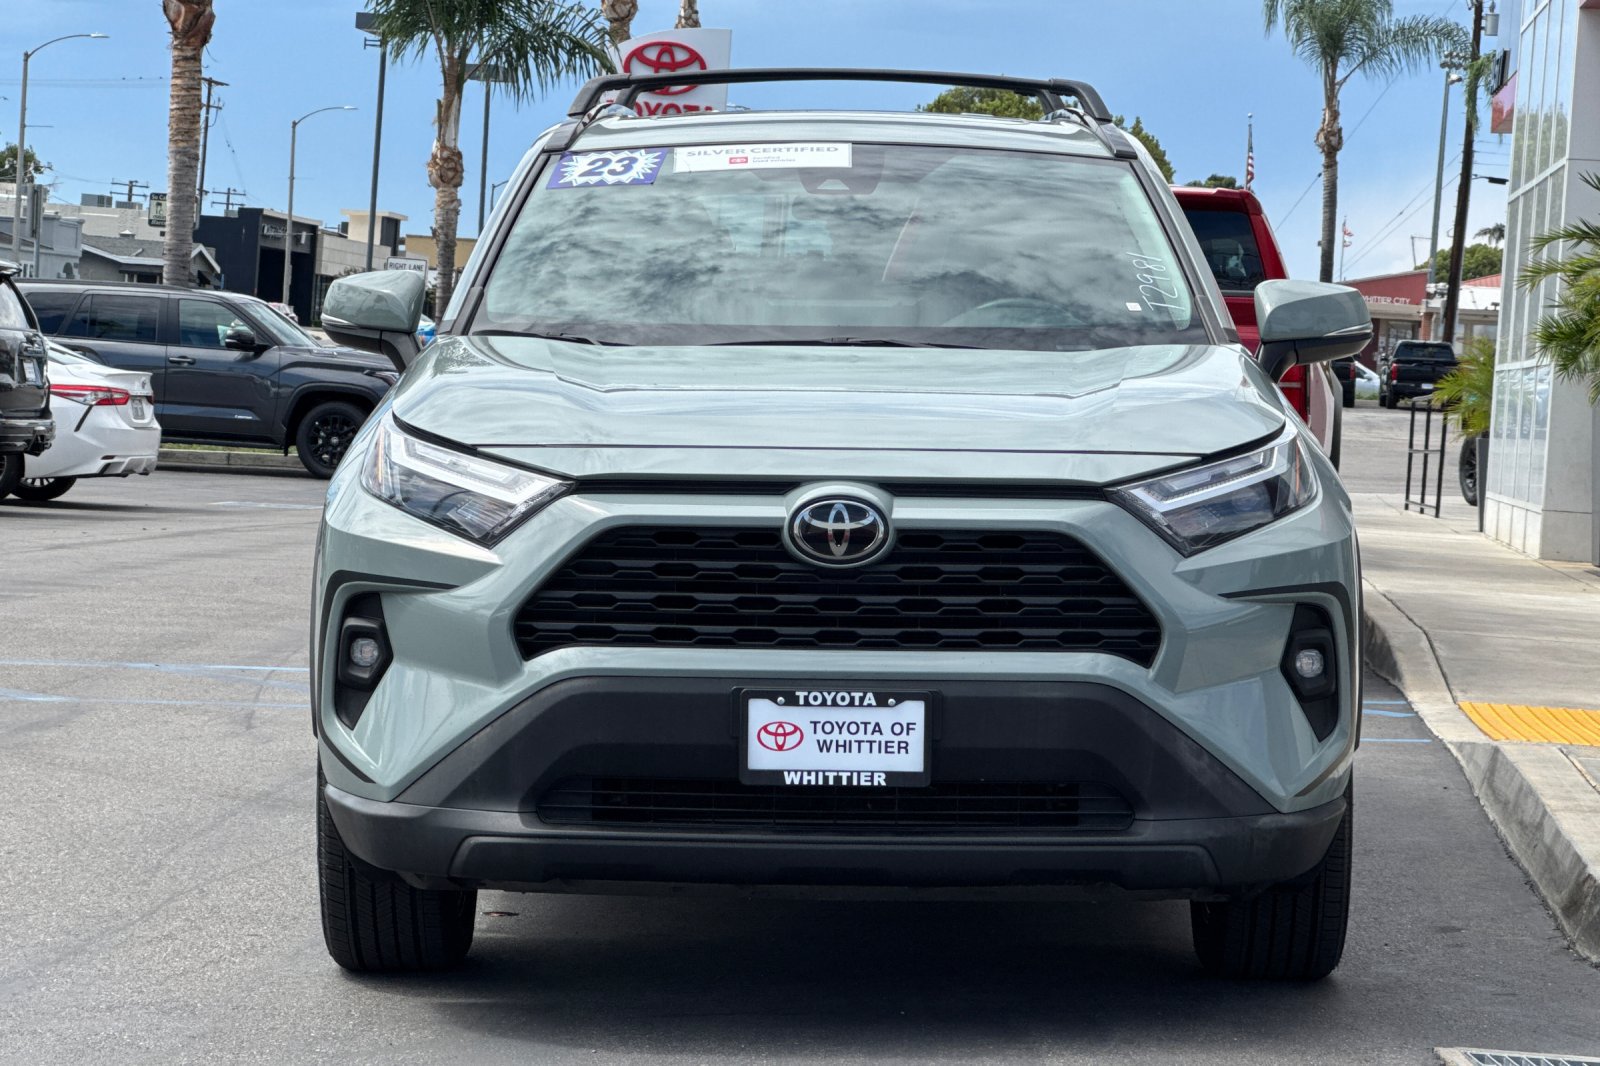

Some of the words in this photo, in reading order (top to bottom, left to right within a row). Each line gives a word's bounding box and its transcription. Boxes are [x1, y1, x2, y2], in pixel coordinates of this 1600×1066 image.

[687, 148, 746, 156] SILVER
[751, 146, 839, 154] CERTIFIED
[577, 156, 639, 177] 23
[389, 262, 406, 270] RIGHT
[408, 263, 424, 271] LANE
[1393, 297, 1411, 305] CITY
[795, 691, 877, 706] TOYOTA
[810, 720, 883, 736] TOYOTA
[890, 722, 917, 736] OF
[816, 739, 910, 754] WHITTIER
[783, 771, 887, 786] WHITTIER
